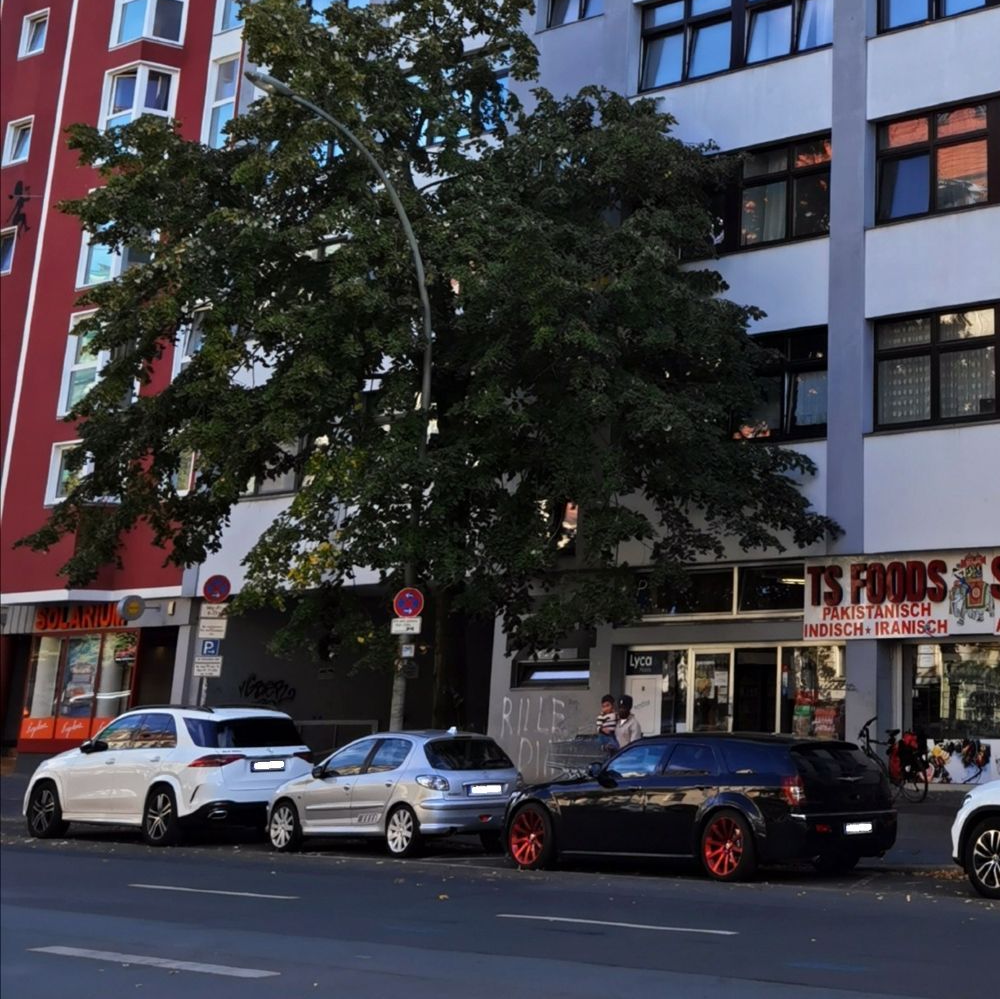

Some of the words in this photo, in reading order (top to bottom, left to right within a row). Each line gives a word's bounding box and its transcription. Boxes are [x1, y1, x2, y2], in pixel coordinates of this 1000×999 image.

[807, 565, 843, 606] TS
[851, 559, 948, 605] FOODS
[822, 602, 931, 621] PAKISTANISCH
[804, 622, 863, 638] INDISCH
[875, 619, 948, 636] IRANISCH
[203, 641, 214, 655] P
[629, 654, 653, 669] Lyca
